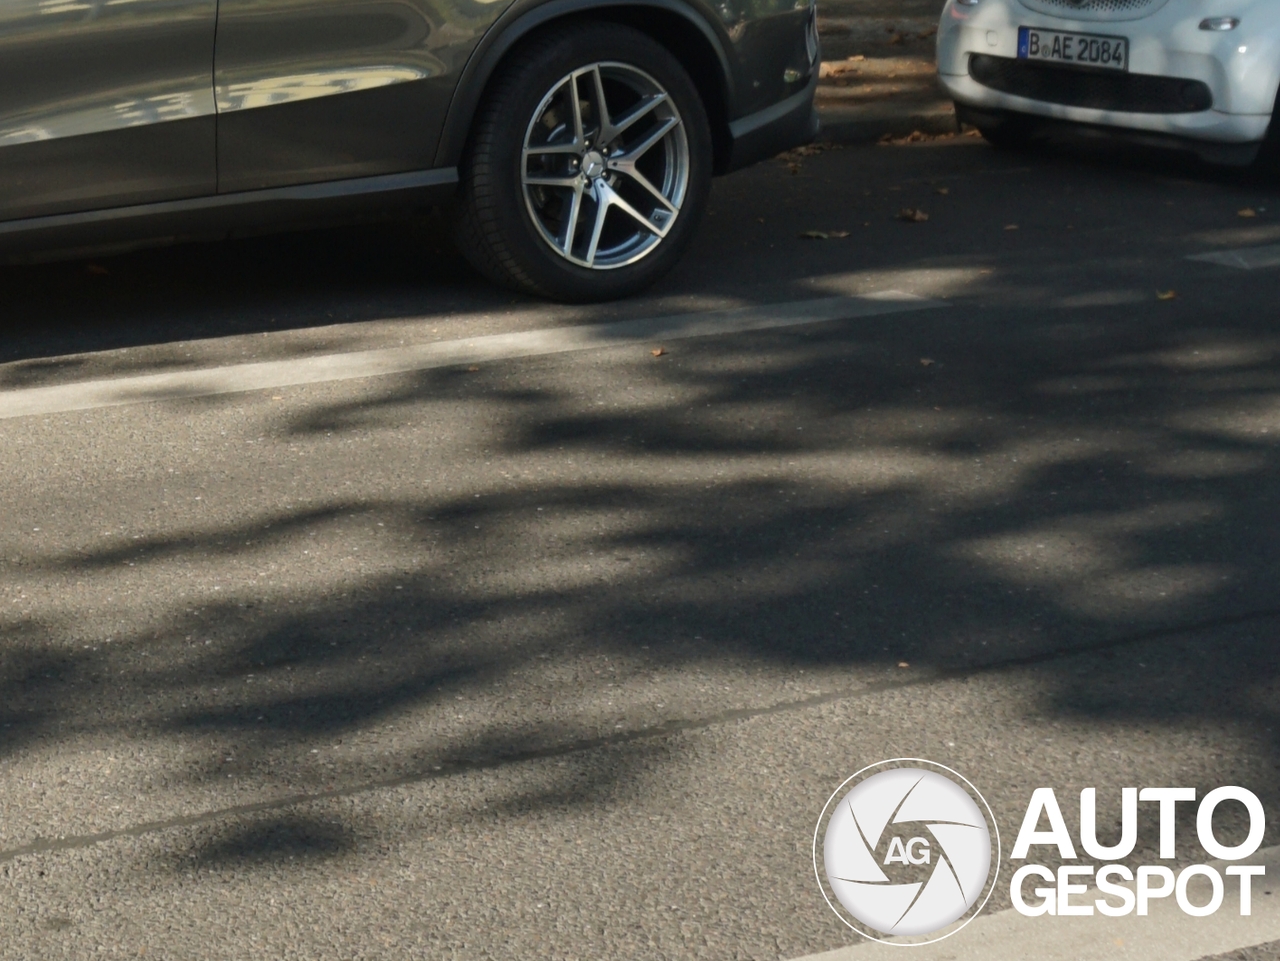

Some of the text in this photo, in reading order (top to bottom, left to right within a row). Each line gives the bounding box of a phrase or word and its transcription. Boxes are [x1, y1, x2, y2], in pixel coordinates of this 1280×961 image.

[1029, 33, 1123, 66] B AE 2084
